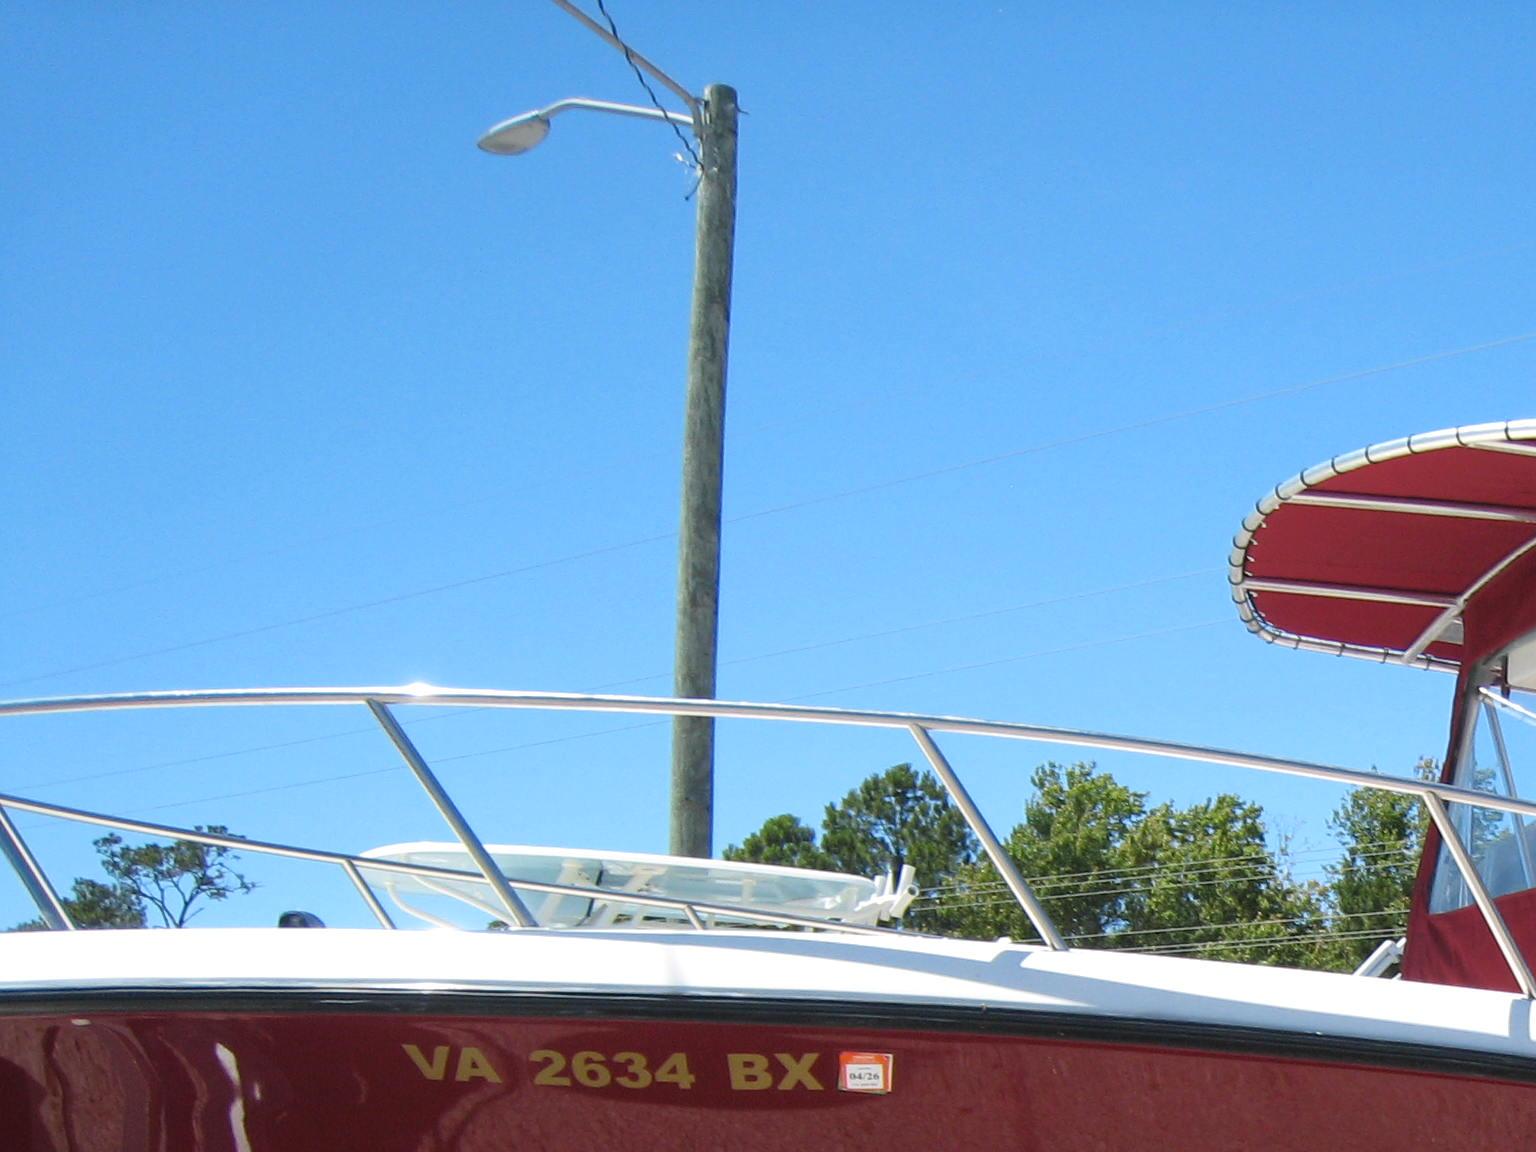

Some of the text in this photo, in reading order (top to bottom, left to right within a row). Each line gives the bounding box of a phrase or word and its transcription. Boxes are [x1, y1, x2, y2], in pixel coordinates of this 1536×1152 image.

[402, 1043, 824, 1091] VA 2634 BX
